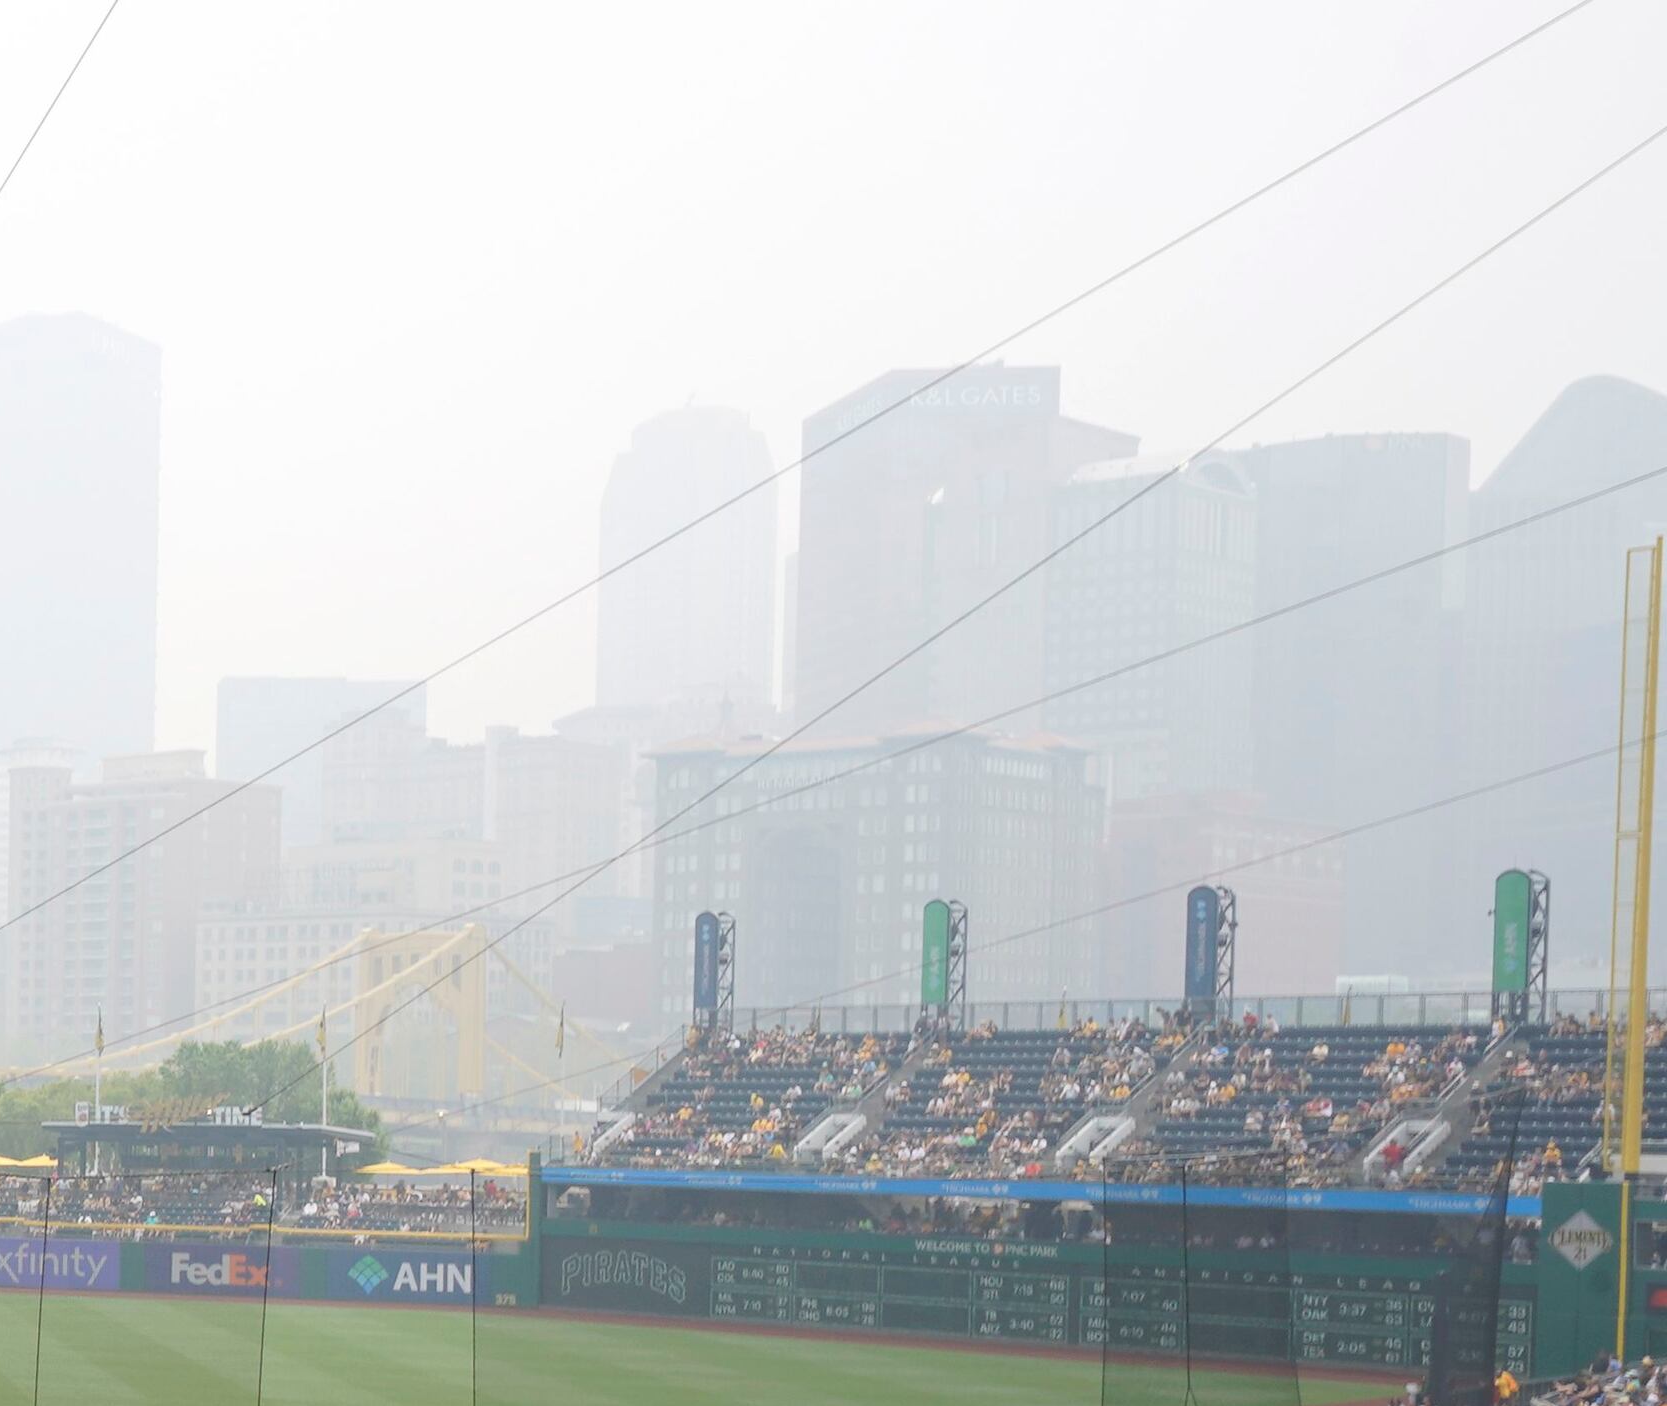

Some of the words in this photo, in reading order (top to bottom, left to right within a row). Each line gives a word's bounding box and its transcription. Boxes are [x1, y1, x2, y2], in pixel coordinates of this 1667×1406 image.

[213, 1105, 264, 1126] TIME
[914, 1239, 972, 1254] WELCOME
[973, 1241, 990, 1254] TO
[1005, 1244, 1028, 1256] PNC
[1030, 1245, 1059, 1258] PARK
[170, 1252, 269, 1285] FedEx
[392, 1262, 472, 1294] AHN
[561, 1249, 688, 1304] PIRATES
